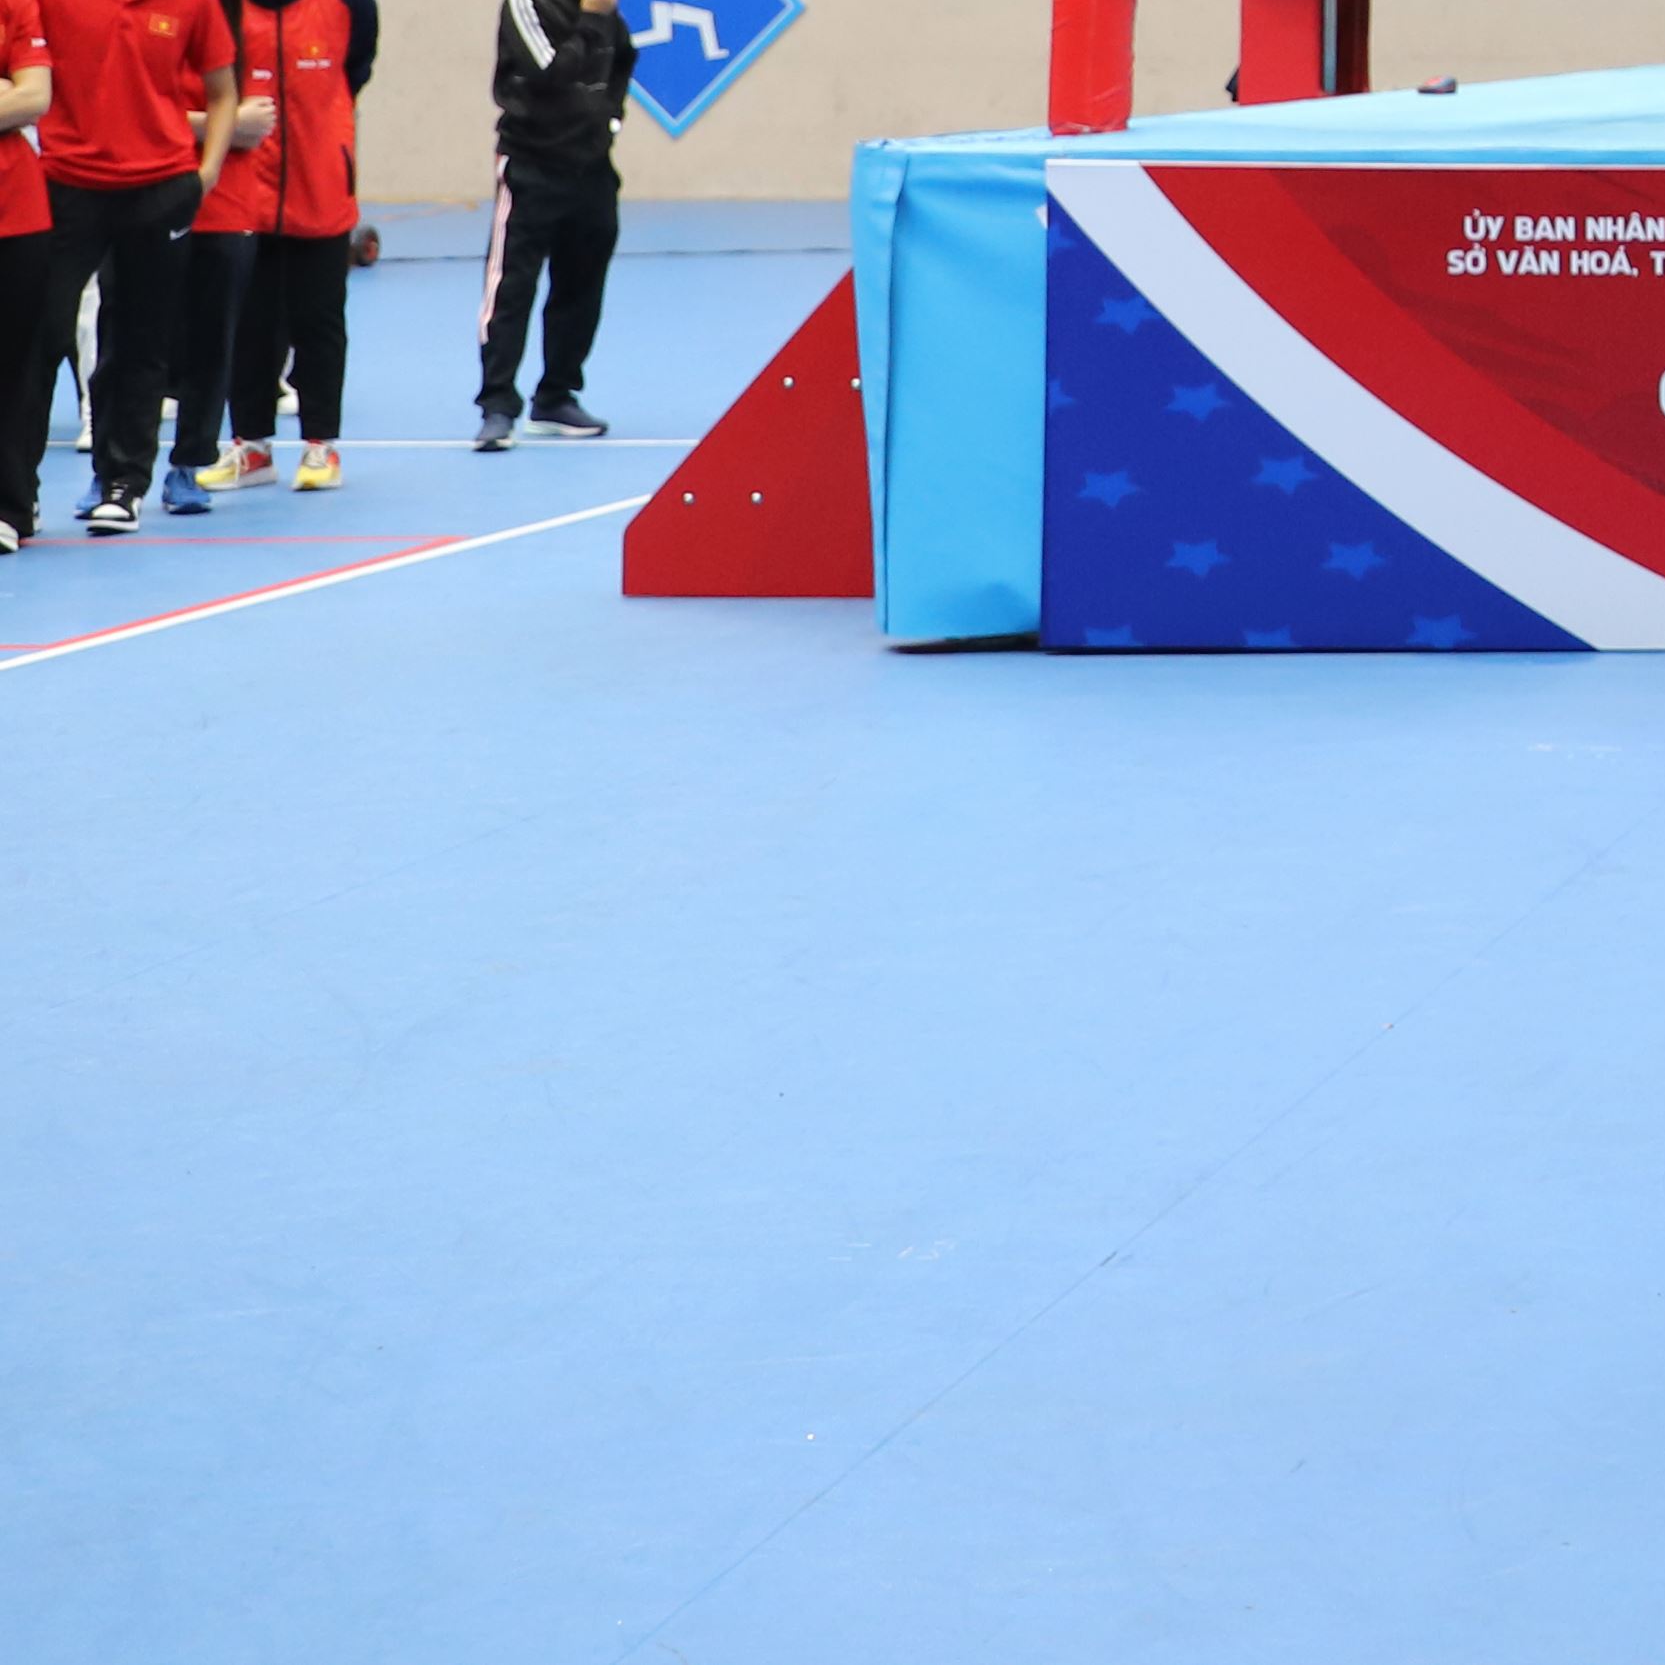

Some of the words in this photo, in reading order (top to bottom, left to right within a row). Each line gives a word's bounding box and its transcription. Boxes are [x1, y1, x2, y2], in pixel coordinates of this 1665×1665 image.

[1464, 209, 1504, 241] ỦY
[1515, 217, 1575, 241] BAN
[1586, 213, 1665, 241] NHÂN
[1448, 243, 1487, 275] SỞ
[1498, 245, 1559, 275] VĂN
